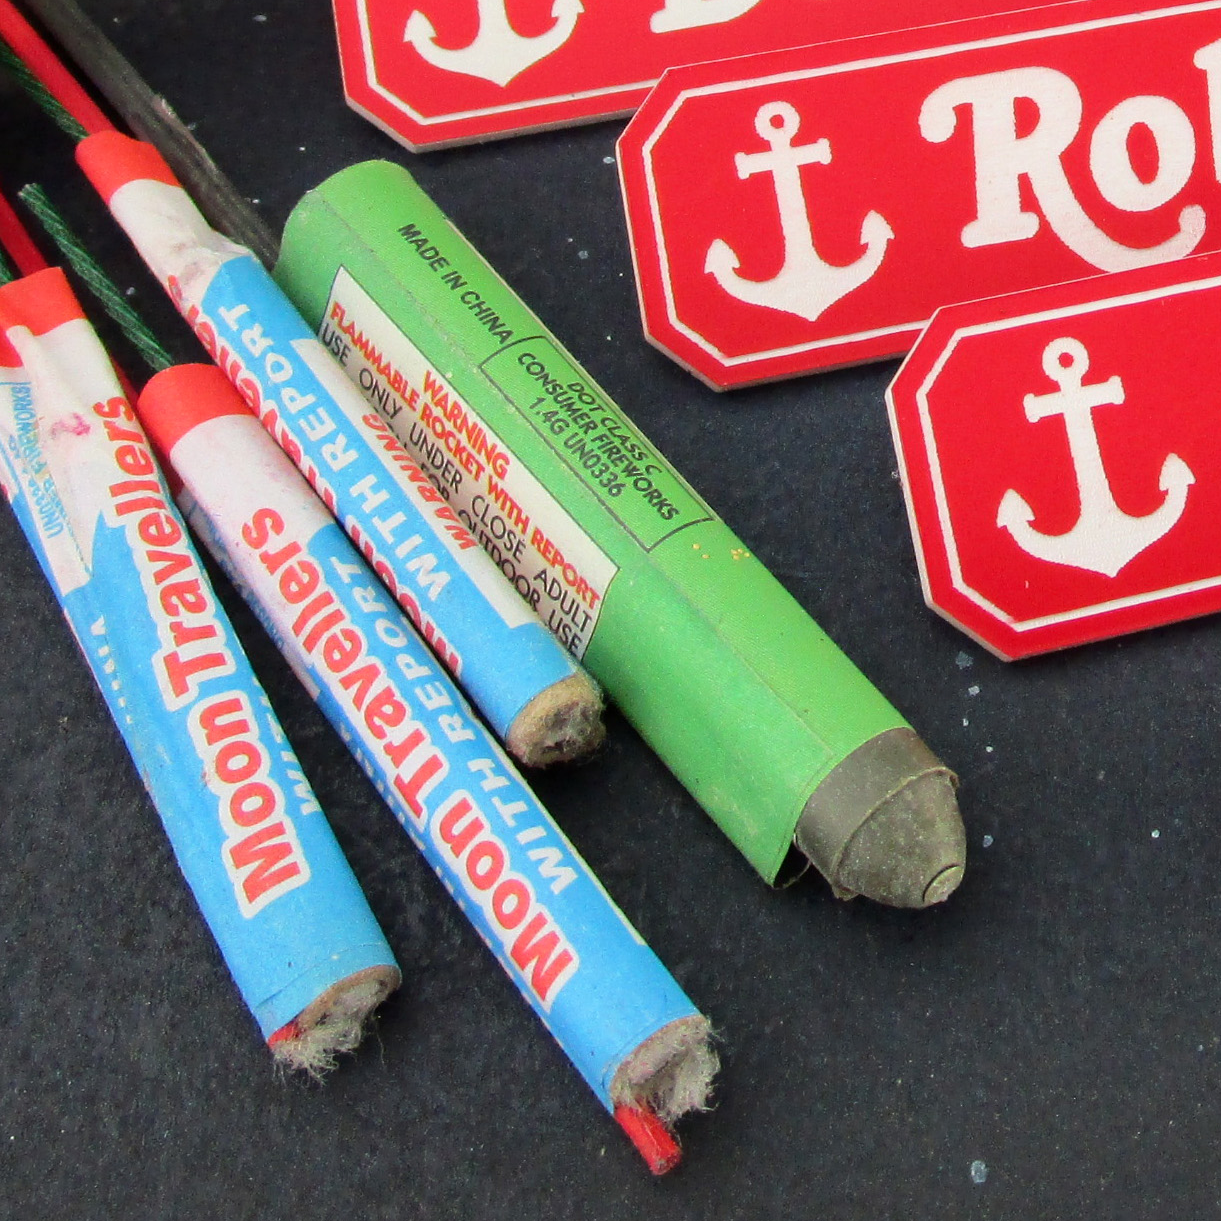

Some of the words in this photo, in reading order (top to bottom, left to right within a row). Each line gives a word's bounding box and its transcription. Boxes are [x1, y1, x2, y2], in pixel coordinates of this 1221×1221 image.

[399, 222, 450, 273] MADE
[440, 269, 467, 292] IN
[460, 289, 513, 345] CHINA
[217, 303, 359, 473] REPORT
[330, 301, 421, 413] FLAMMABLE
[419, 402, 487, 483] ROCKET
[487, 474, 530, 535] WITH
[530, 526, 601, 610] REPORT
[422, 369, 511, 481] WARNING
[516, 351, 599, 436] CONSUMER
[597, 432, 680, 522] FIREWORKS
[528, 396, 569, 437] 1.4G
[562, 431, 626, 498] UN0336
[566, 381, 603, 414] DOT
[599, 415, 647, 463] CLASS
[644, 463, 663, 478] C
[92, 395, 228, 700] Travellers
[321, 323, 352, 368] USE
[358, 367, 403, 420] ONLY
[409, 422, 463, 495] UNDER
[471, 495, 527, 564] CLOSE
[534, 568, 593, 633] ADULT
[348, 473, 451, 602] WITH
[361, 413, 478, 550] WARNING
[241, 507, 444, 820] Travellers
[329, 554, 476, 744] REPORT
[547, 608, 586, 659] USE
[198, 696, 302, 905] Moon
[466, 757, 578, 896] WITH
[439, 796, 576, 1003] Moon
